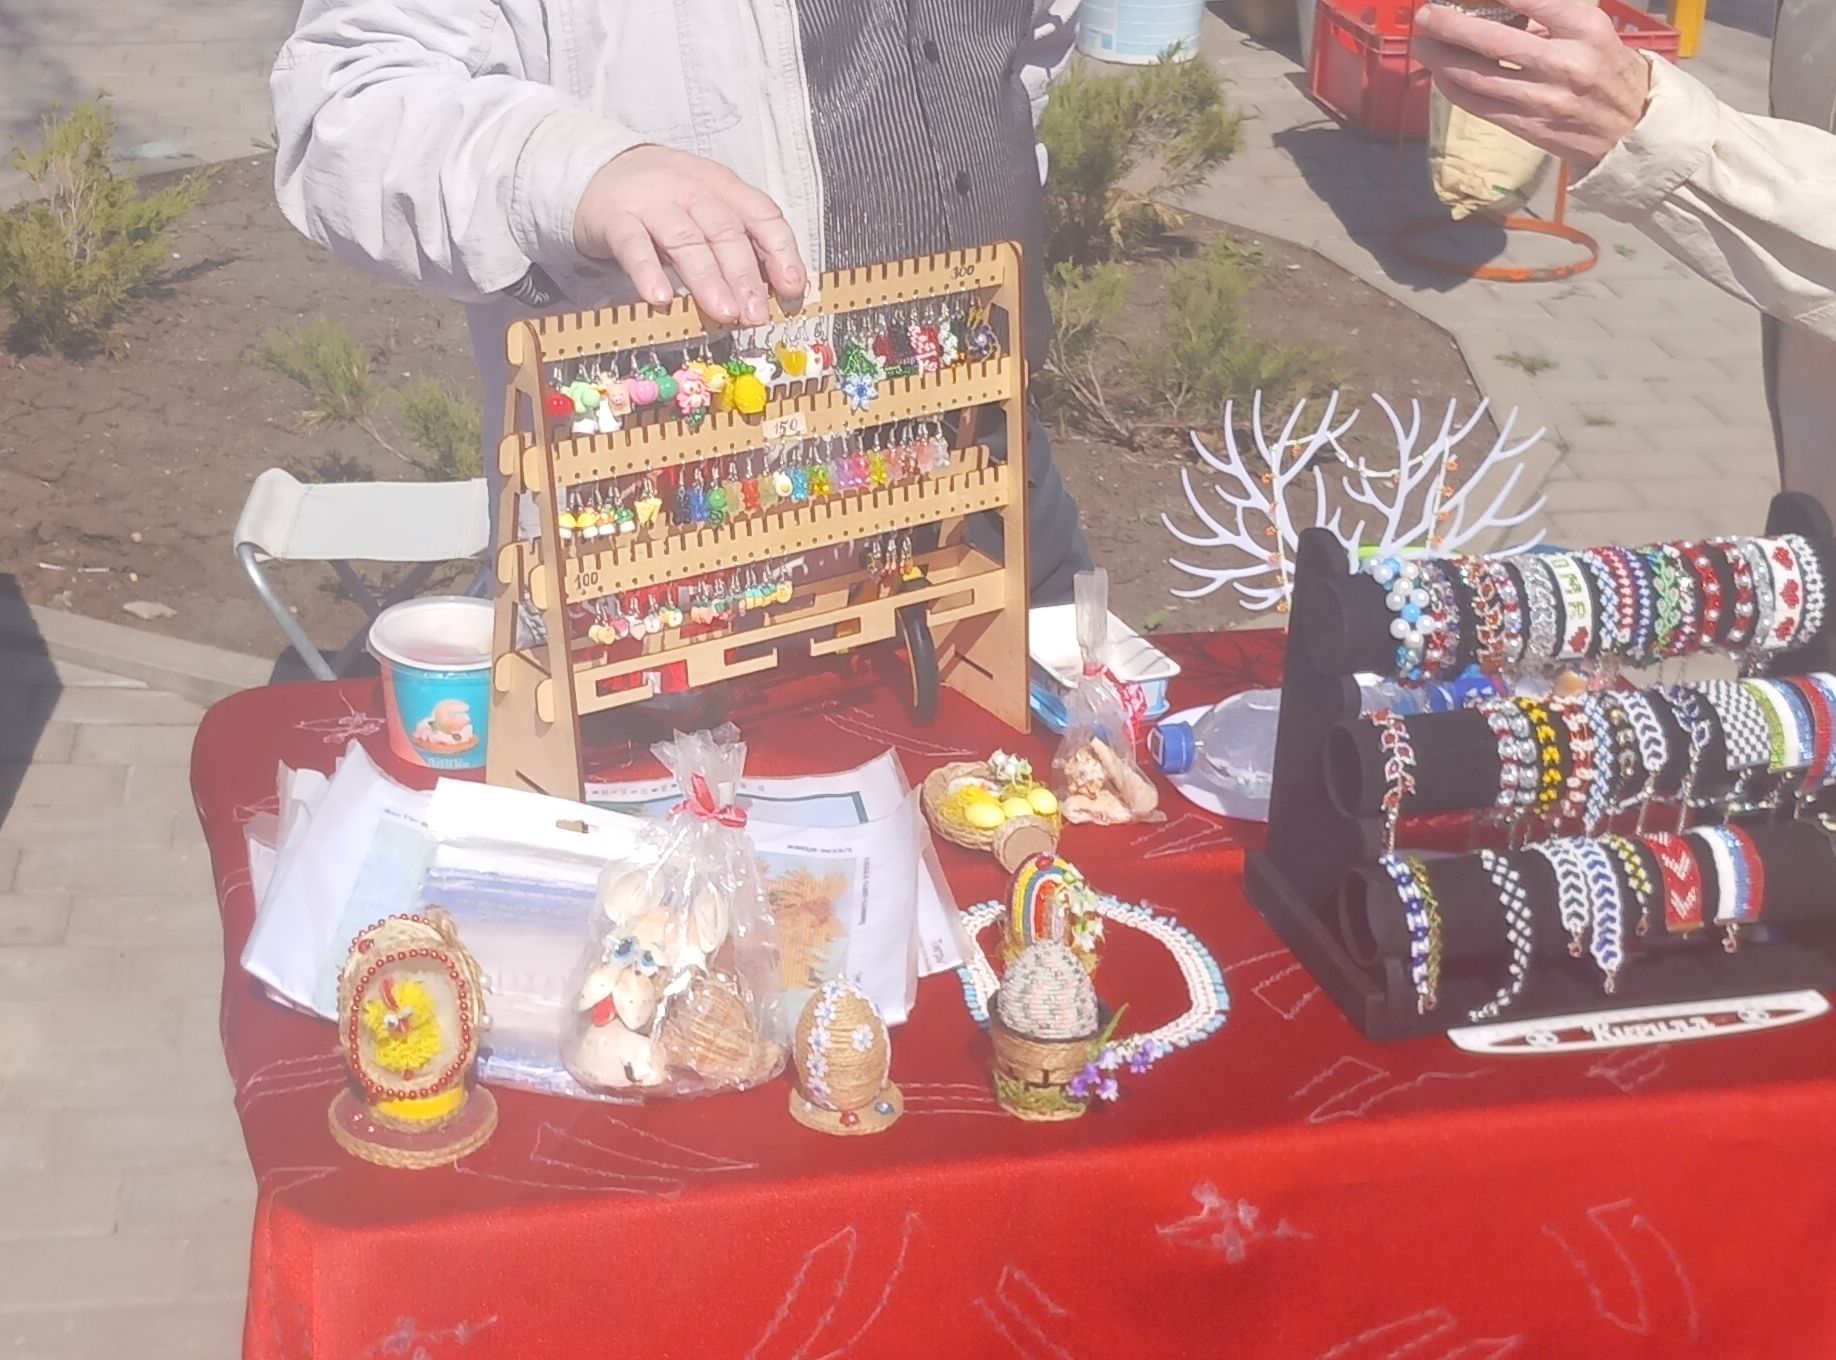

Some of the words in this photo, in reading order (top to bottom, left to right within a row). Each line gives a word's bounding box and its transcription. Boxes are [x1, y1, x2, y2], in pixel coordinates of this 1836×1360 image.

[951, 264, 975, 280] 300
[773, 418, 797, 435] 150
[574, 571, 599, 590] 100
